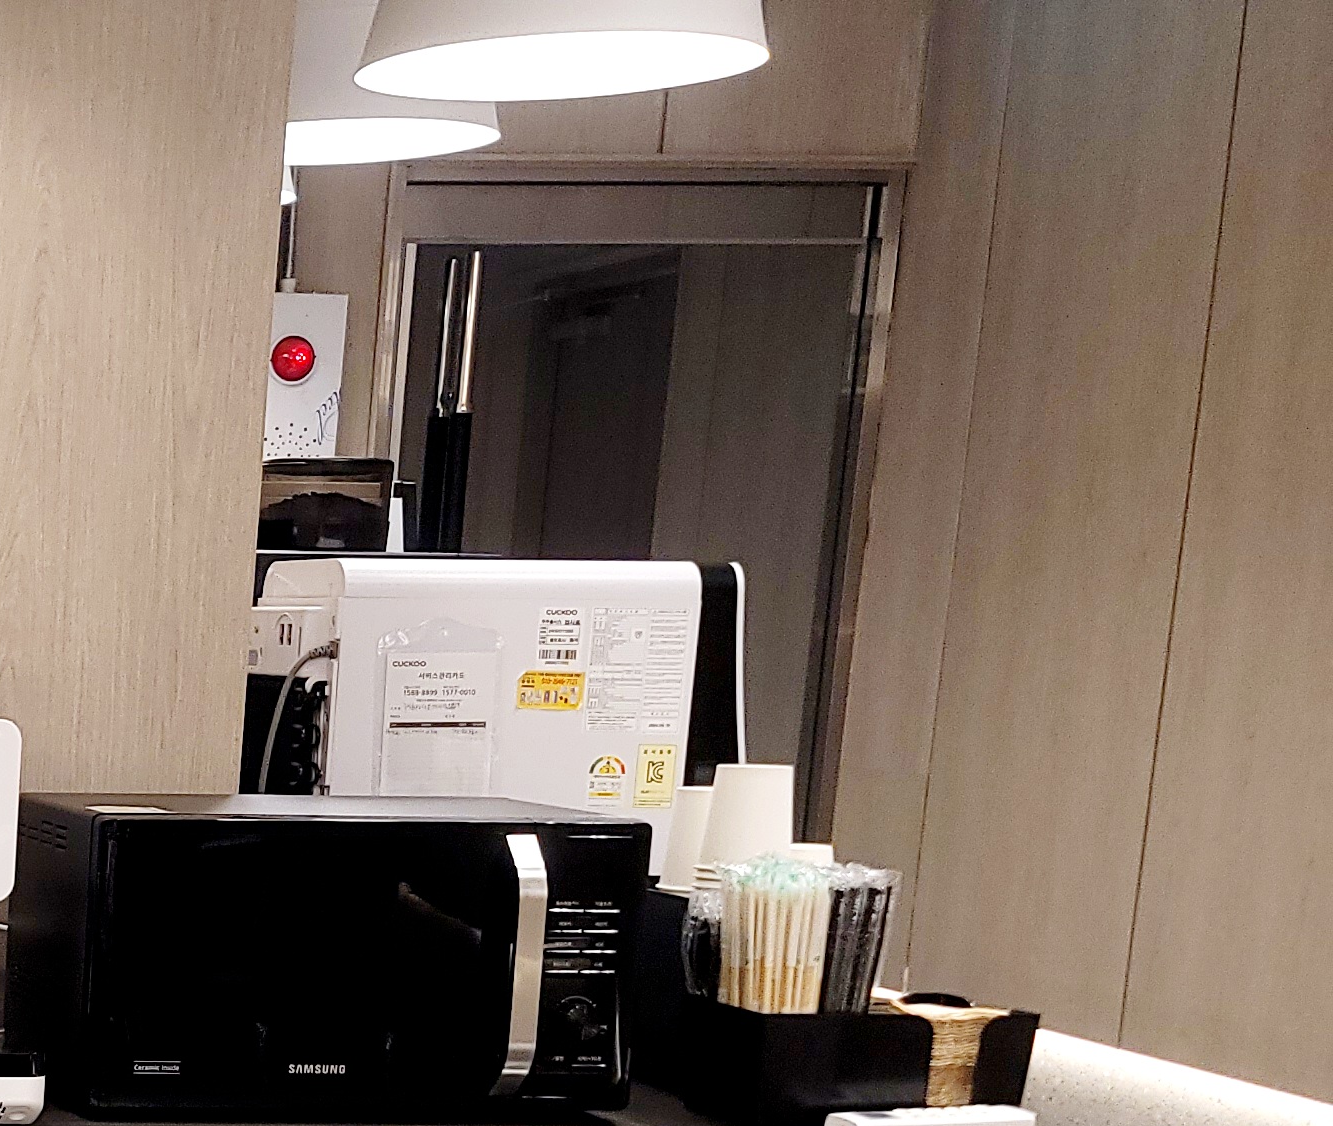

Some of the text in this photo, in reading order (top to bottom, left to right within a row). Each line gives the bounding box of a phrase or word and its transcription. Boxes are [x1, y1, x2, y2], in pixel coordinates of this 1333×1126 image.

[392, 660, 427, 668] CUCKOO
[441, 688, 476, 696] 1577-0010
[288, 1064, 346, 1075] SAMSUNG
